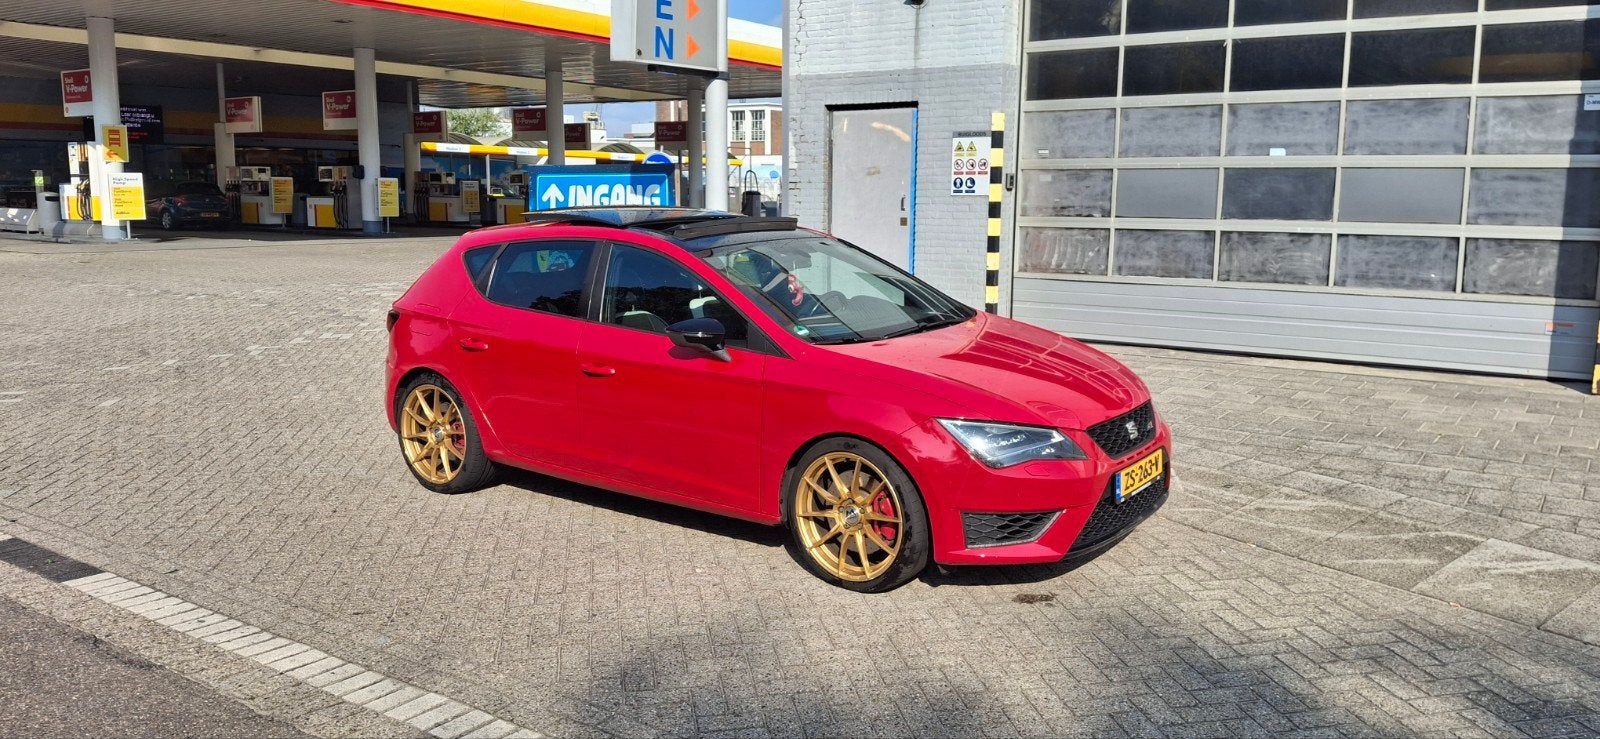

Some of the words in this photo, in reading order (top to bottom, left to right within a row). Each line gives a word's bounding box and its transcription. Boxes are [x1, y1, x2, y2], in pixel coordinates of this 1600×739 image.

[66, 84, 88, 93] V-Power
[326, 103, 350, 111] V-Power
[568, 183, 661, 207] INGANG
[1124, 453, 1160, 492] ZS-263-V
